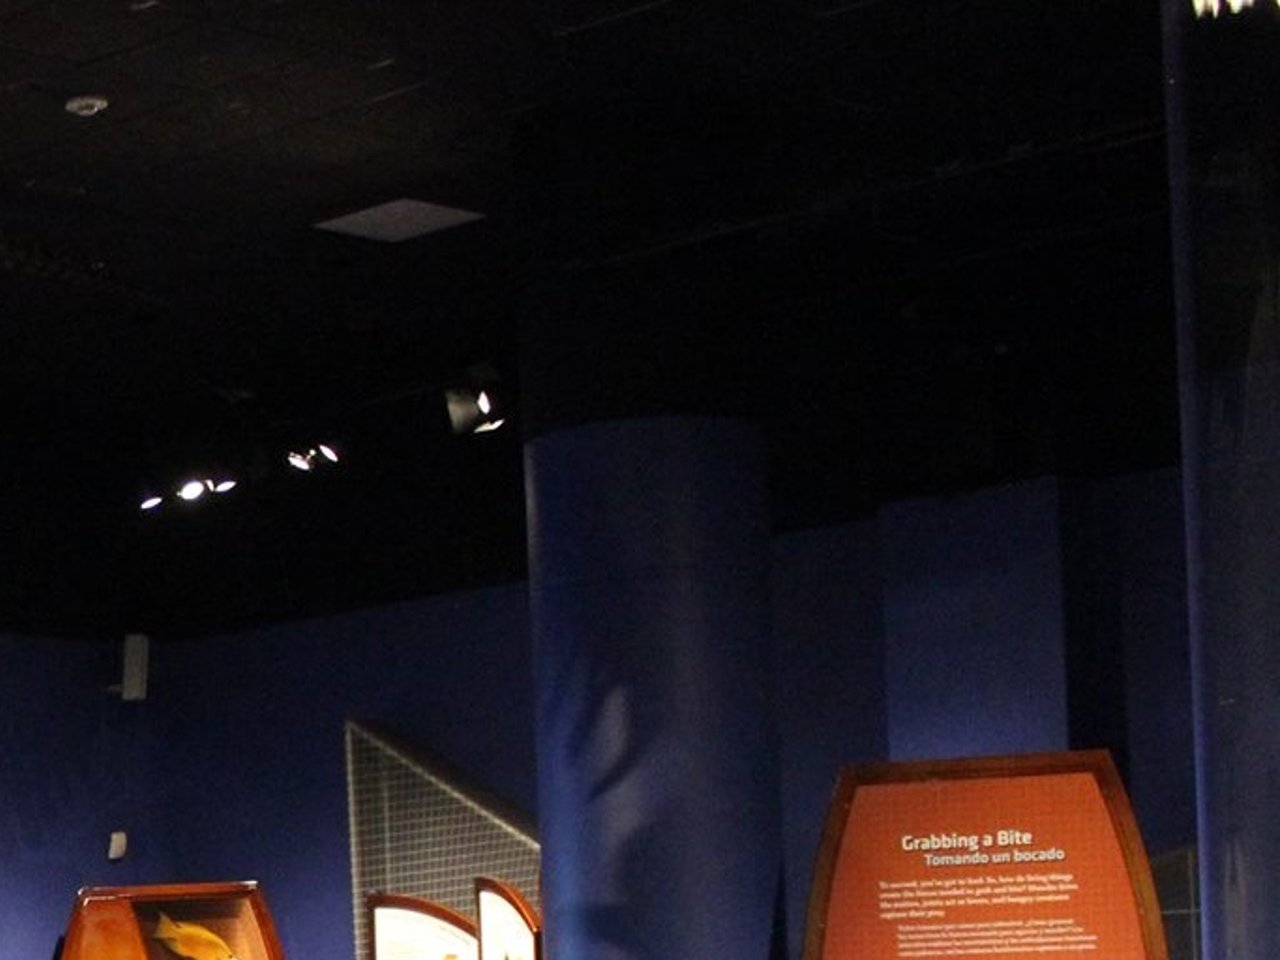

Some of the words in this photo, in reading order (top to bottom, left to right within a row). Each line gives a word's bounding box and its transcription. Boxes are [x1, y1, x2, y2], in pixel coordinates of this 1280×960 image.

[901, 834, 978, 851] Grabbing
[982, 835, 992, 847] a
[997, 830, 1032, 845] Bite
[924, 852, 989, 866] Tomando
[991, 853, 1010, 863] un
[1014, 848, 1066, 862] bocado
